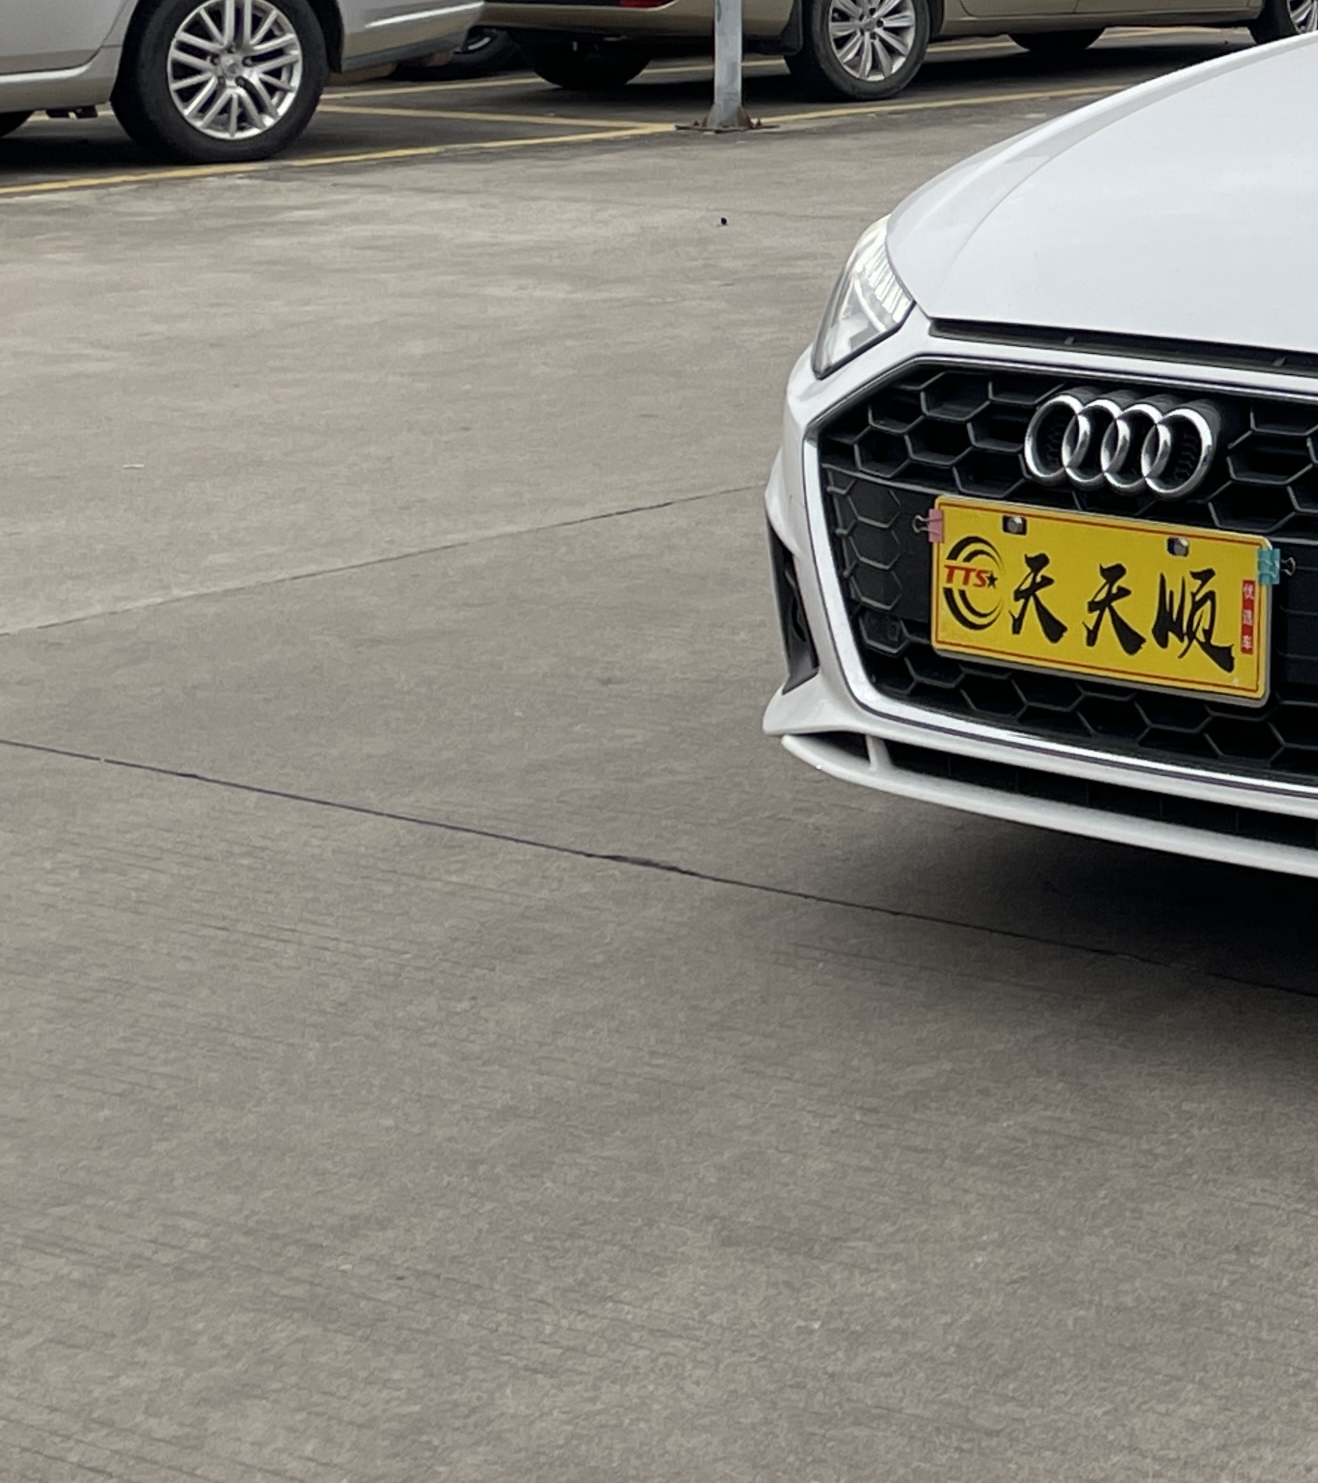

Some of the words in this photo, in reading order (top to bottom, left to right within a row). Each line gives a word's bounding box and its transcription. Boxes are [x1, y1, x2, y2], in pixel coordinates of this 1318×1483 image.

[944, 565, 988, 588] TTS
[1008, 552, 1236, 673] 天天顺
